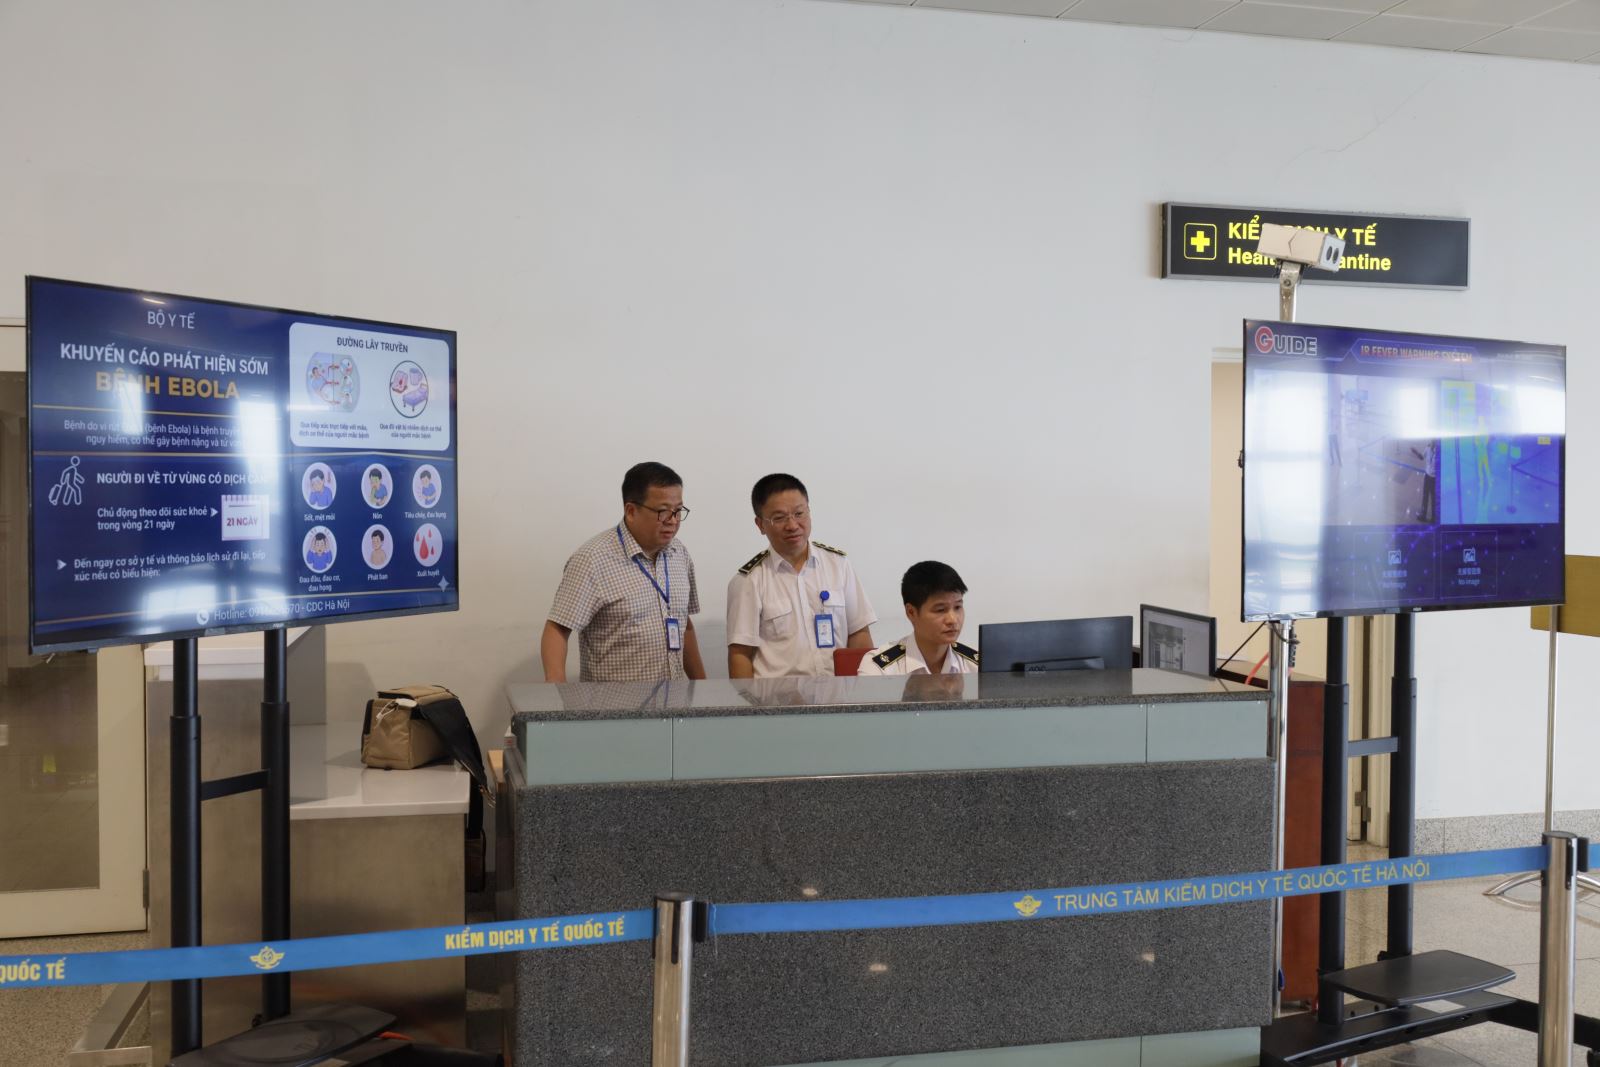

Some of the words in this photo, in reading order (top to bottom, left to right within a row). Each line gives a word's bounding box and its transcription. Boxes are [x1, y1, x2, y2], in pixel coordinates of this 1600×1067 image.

[1228, 215, 1260, 240] KIỂ
[1334, 228, 1347, 241] Y
[1352, 223, 1377, 246] TẾ
[147, 308, 165, 328] BỘ
[168, 314, 176, 327] Y
[179, 312, 195, 329] TẾ
[337, 336, 364, 348] ĐƯỜNG
[365, 339, 379, 350] LÂY
[380, 341, 409, 353] TRUYỀN
[1255, 326, 1318, 356] GUIDE
[61, 343, 124, 363] KHUYẾN
[128, 347, 160, 366] CÁO
[163, 351, 201, 370] PHÁT
[204, 354, 236, 375] HIỆN
[239, 357, 268, 375] SỚM
[168, 376, 240, 399] EBOLA
[64, 420, 86, 431] Bệnh
[87, 421, 97, 431] do
[168, 424, 191, 435] Ebola)
[193, 425, 199, 434] là
[201, 426, 219, 437] bệnh
[86, 435, 106, 446] nguy
[142, 434, 156, 445] thể
[156, 436, 170, 447] gây
[171, 436, 190, 447] bệnh
[191, 437, 209, 448] nặng
[211, 438, 219, 447] và
[96, 470, 132, 484] NGƯỜI
[134, 473, 145, 484] ĐI
[147, 470, 161, 484] VỀ
[162, 471, 178, 484] TỪ
[178, 471, 206, 484] VÙNG
[208, 472, 222, 484] CÓ
[224, 474, 246, 486] DỊCH
[97, 506, 115, 518] Chủ
[116, 507, 138, 519] động
[139, 507, 158, 517] theo
[158, 506, 172, 516] dõi
[173, 506, 188, 516] sức
[226, 517, 235, 527] 21
[97, 521, 120, 532] trong
[121, 520, 142, 531] vòng
[144, 519, 154, 529] 21
[156, 519, 176, 530] ngày
[74, 557, 92, 569] Đến
[93, 559, 114, 570] ngay
[115, 558, 127, 566] cơ
[128, 555, 139, 566] sở
[140, 558, 145, 567] y
[146, 554, 155, 565] tế
[156, 555, 166, 564] và
[167, 553, 190, 565] thông
[191, 552, 205, 563] báo
[207, 552, 220, 562] lịch
[221, 551, 232, 561] sử
[232, 551, 240, 561] đi
[74, 571, 90, 581] xúc
[92, 570, 108, 580] nếu
[109, 569, 120, 579] có
[122, 567, 140, 579] biểu
[214, 609, 247, 621] Hotline:
[306, 601, 324, 612] CDC
[325, 600, 336, 611] Hà
[337, 599, 350, 610] Nội
[1054, 891, 1118, 911] TRUNG
[1122, 886, 1159, 906] TÂM
[1165, 883, 1206, 902] KIỂM
[1211, 880, 1252, 900] DỊCH
[1258, 879, 1268, 893] Y
[1274, 873, 1293, 892] TẾ
[1298, 870, 1347, 890] QUỐC
[1351, 864, 1371, 884] TẾ
[1376, 862, 1398, 880] HÀ
[1402, 859, 1430, 880] NỘI
[445, 926, 484, 949] KIỂM
[489, 929, 524, 949] DỊCH
[528, 928, 538, 943] Y
[542, 921, 560, 942] TẾ
[564, 918, 603, 942] QUỐC
[608, 915, 625, 936] TẾ
[46, 956, 67, 980] TẾ
